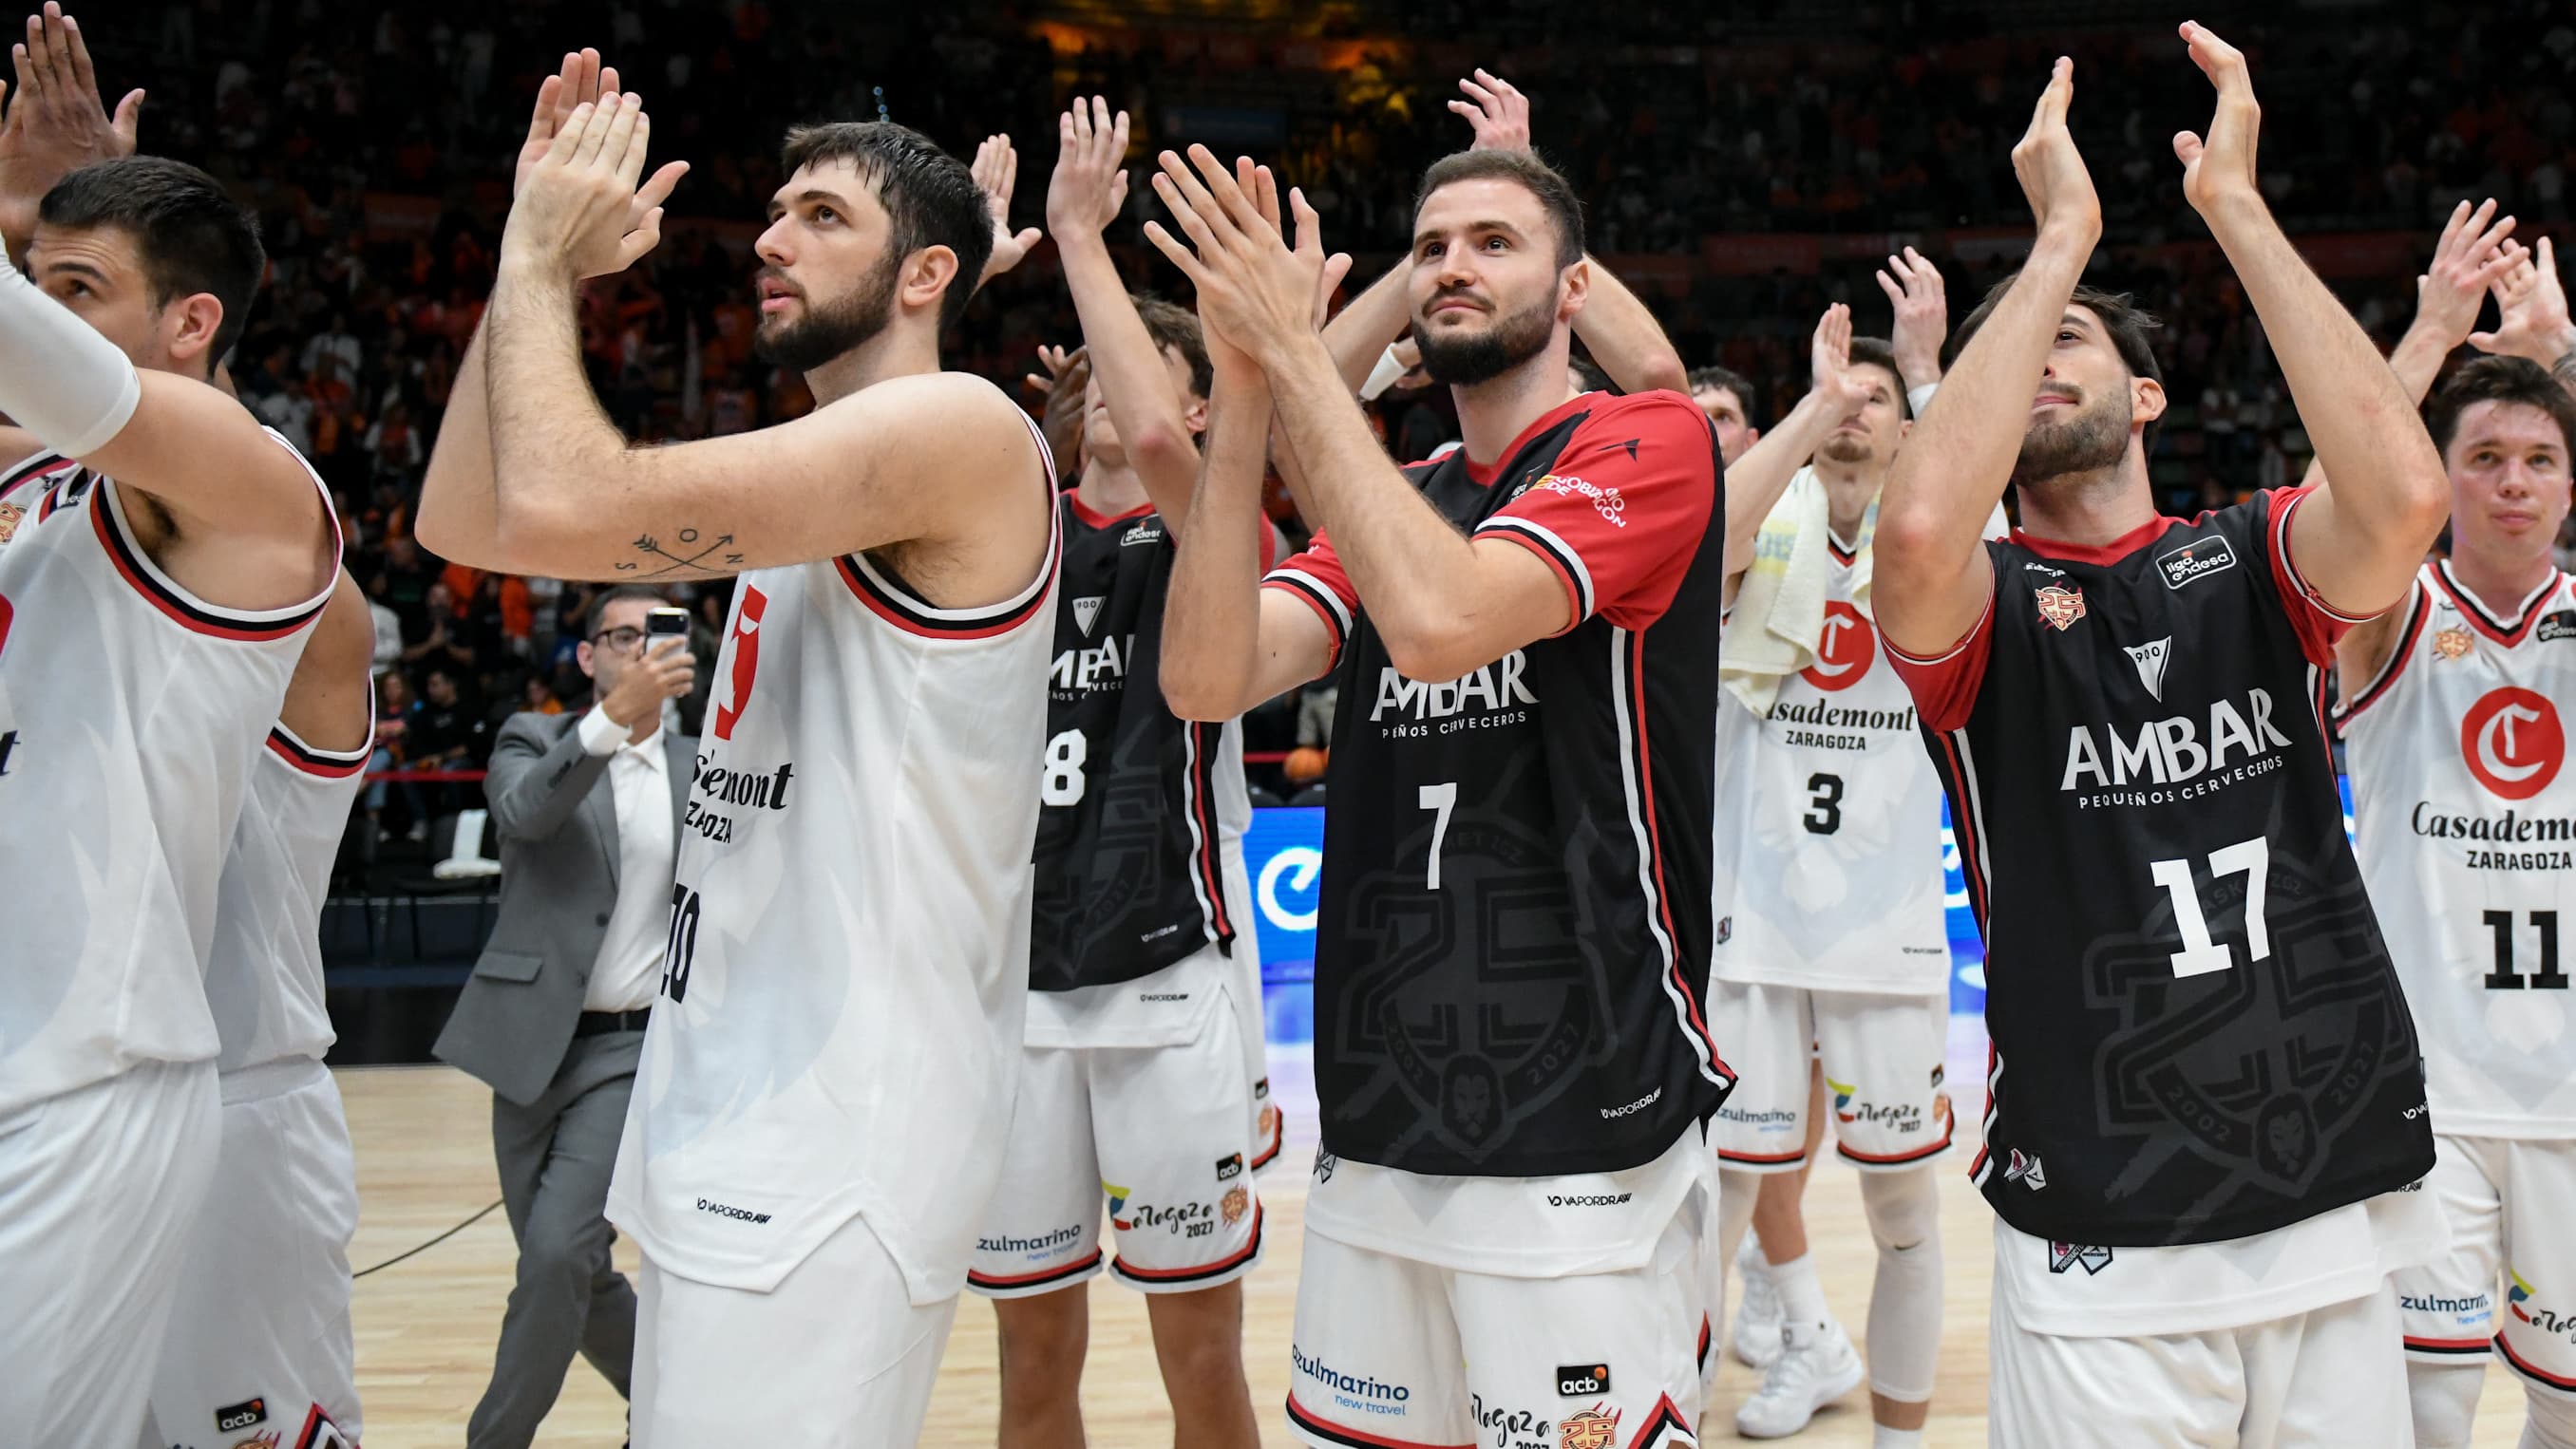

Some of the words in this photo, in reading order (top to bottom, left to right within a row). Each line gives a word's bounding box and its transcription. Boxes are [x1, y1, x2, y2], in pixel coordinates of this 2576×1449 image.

[2166, 556, 2194, 574] liga
[2171, 553, 2229, 581] endesa
[1369, 649, 1541, 723] AMBAR
[1439, 711, 1526, 735] CERVECEROS
[1785, 730, 1866, 751] ZARAGOZA
[2060, 687, 2293, 791] AMBAR
[2079, 790, 2174, 809] PEQUEÑOS
[2182, 756, 2283, 800] CERVECEROS
[1803, 772, 1845, 836] 3
[2412, 801, 2576, 842] Casadem
[1419, 782, 1457, 890] 7
[2467, 851, 2573, 871] ZARAGOZA
[2150, 836, 2271, 979] 17
[2483, 910, 2569, 990] 11
[708, 1200, 771, 1225] VAPORDRAW
[1563, 1192, 1632, 1207] VAPORDRAW
[976, 1224, 1081, 1251] zulmarino
[1186, 1221, 1213, 1238] 2027
[1293, 1344, 1410, 1402] azulmarino
[1561, 1377, 1600, 1394] acb
[1335, 1394, 1364, 1409] new
[1366, 1401, 1407, 1416] travel
[221, 1411, 257, 1430] acb
